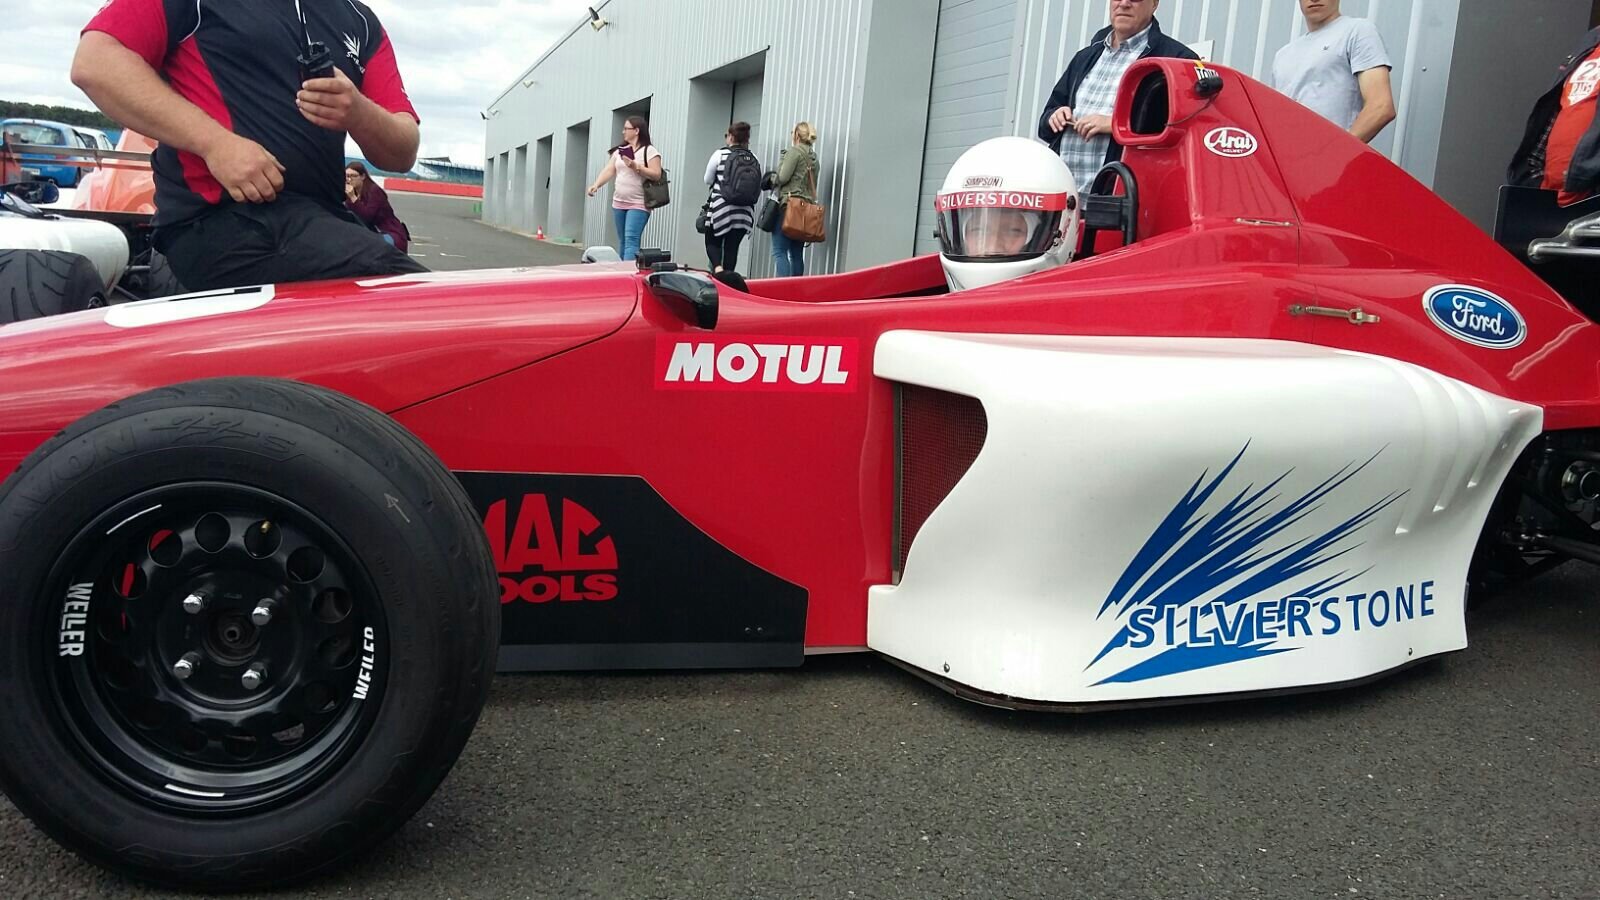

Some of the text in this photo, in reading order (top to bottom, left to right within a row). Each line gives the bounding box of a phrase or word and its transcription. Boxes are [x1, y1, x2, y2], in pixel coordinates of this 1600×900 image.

[1209, 129, 1254, 150] Arai
[941, 192, 1045, 209] SILVERSTONE
[964, 177, 1000, 187] SIMPSON
[1451, 294, 1506, 336] Ford
[664, 342, 849, 385] MOTUL
[59, 581, 95, 657] WEILER
[1128, 580, 1435, 649] SILVERSTONE
